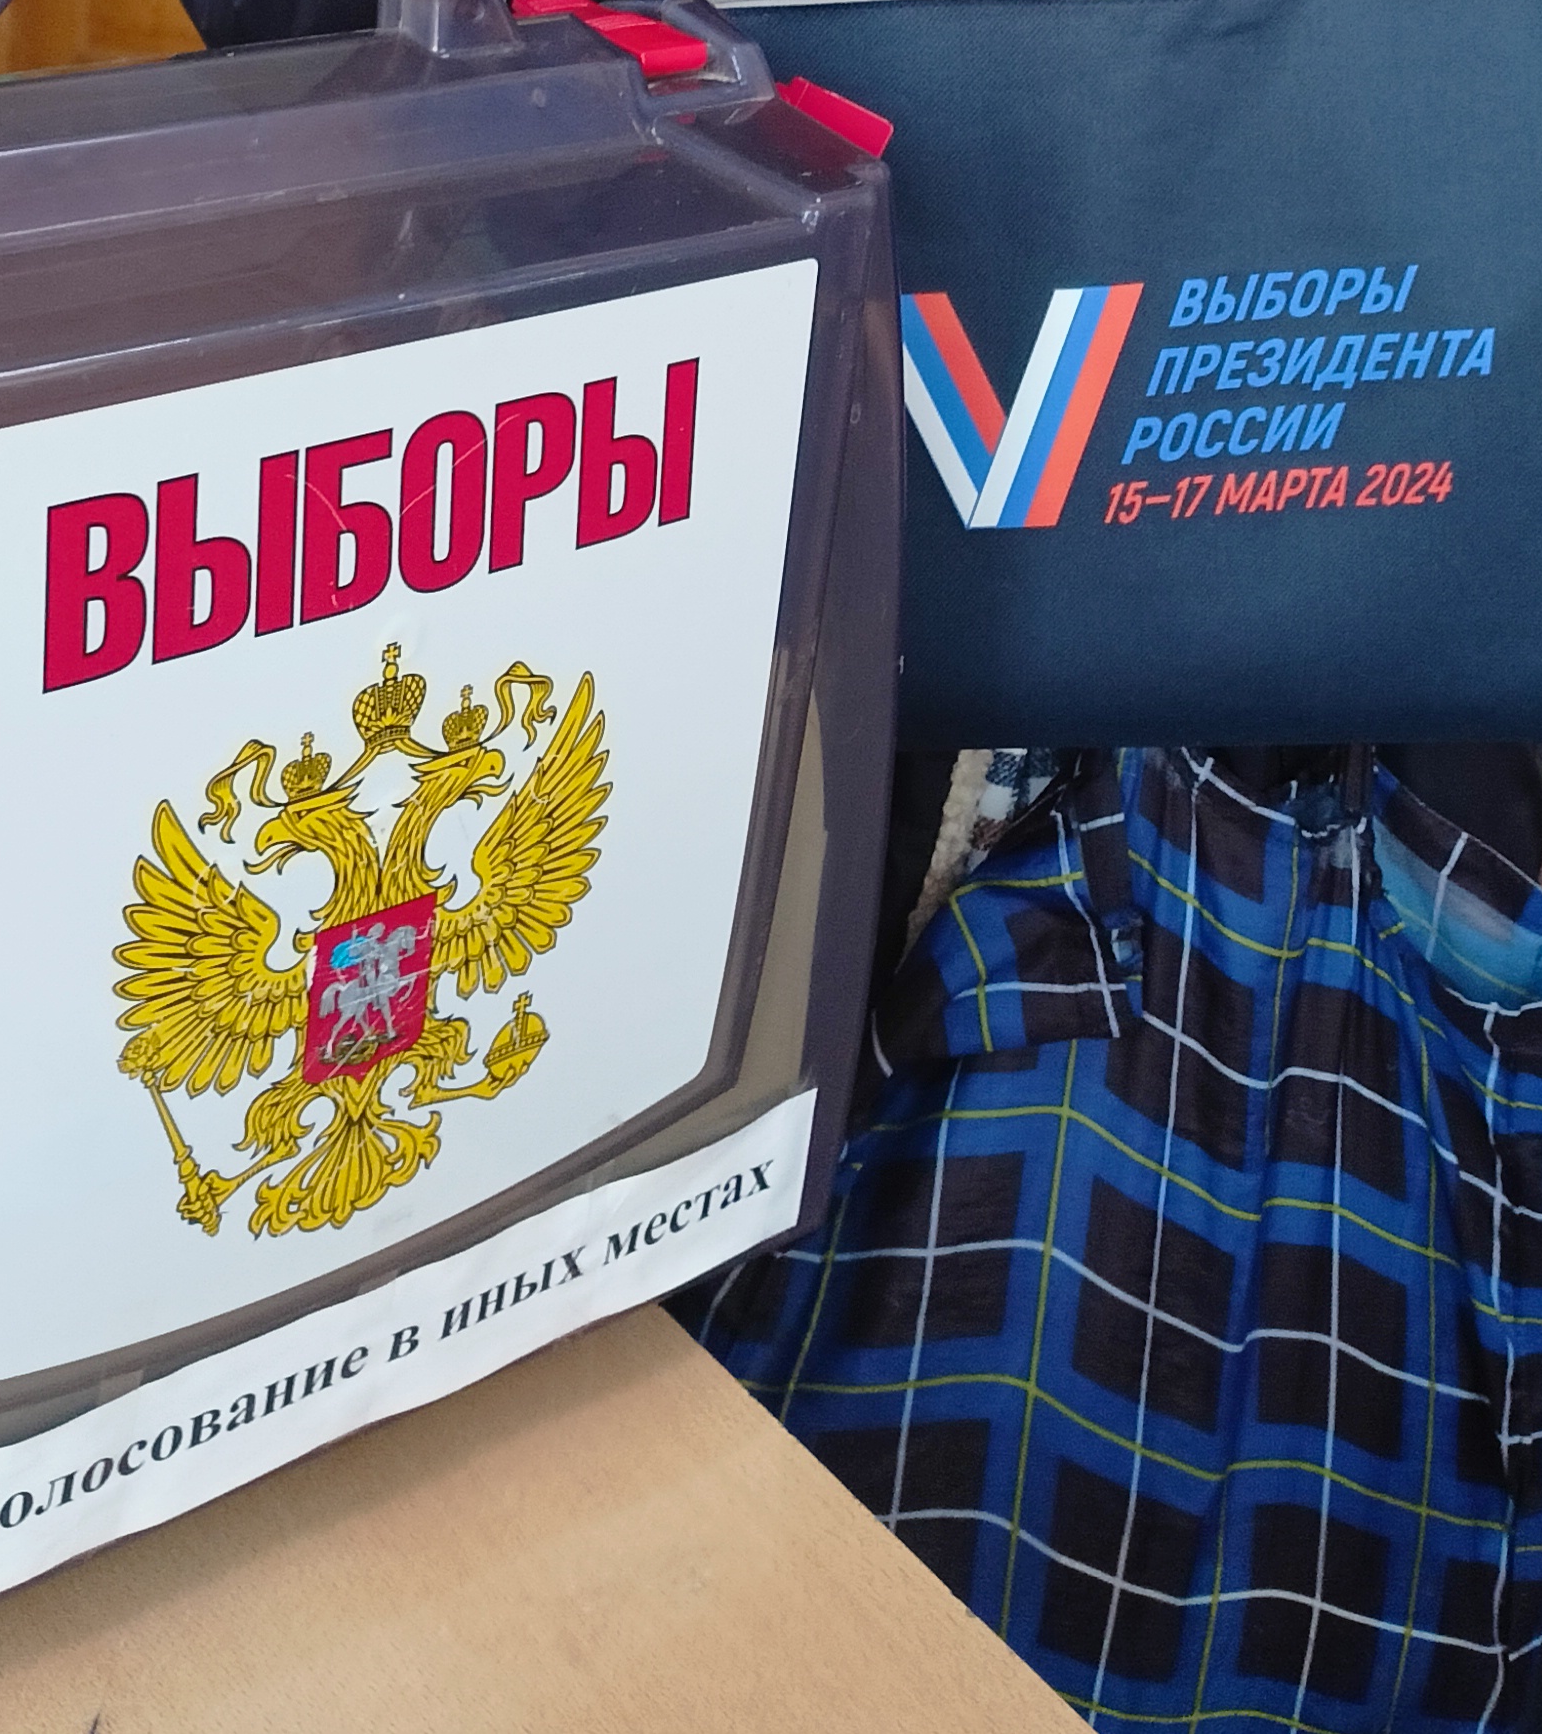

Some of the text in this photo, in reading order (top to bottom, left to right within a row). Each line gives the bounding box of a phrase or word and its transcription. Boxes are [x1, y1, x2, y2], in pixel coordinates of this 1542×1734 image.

[1168, 265, 1419, 329] ВЫБОРЫ
[1146, 327, 1496, 397] ПРЕЗИДЕНТА
[1121, 402, 1346, 465] РОССИИ
[1214, 466, 1348, 517] МАРТА
[1357, 460, 1454, 507] 2024
[42, 356, 701, 694] ВЫБОРЫ
[387, 1322, 421, 1364] в
[440, 1244, 587, 1341] иных
[604, 1157, 776, 1267] местах
